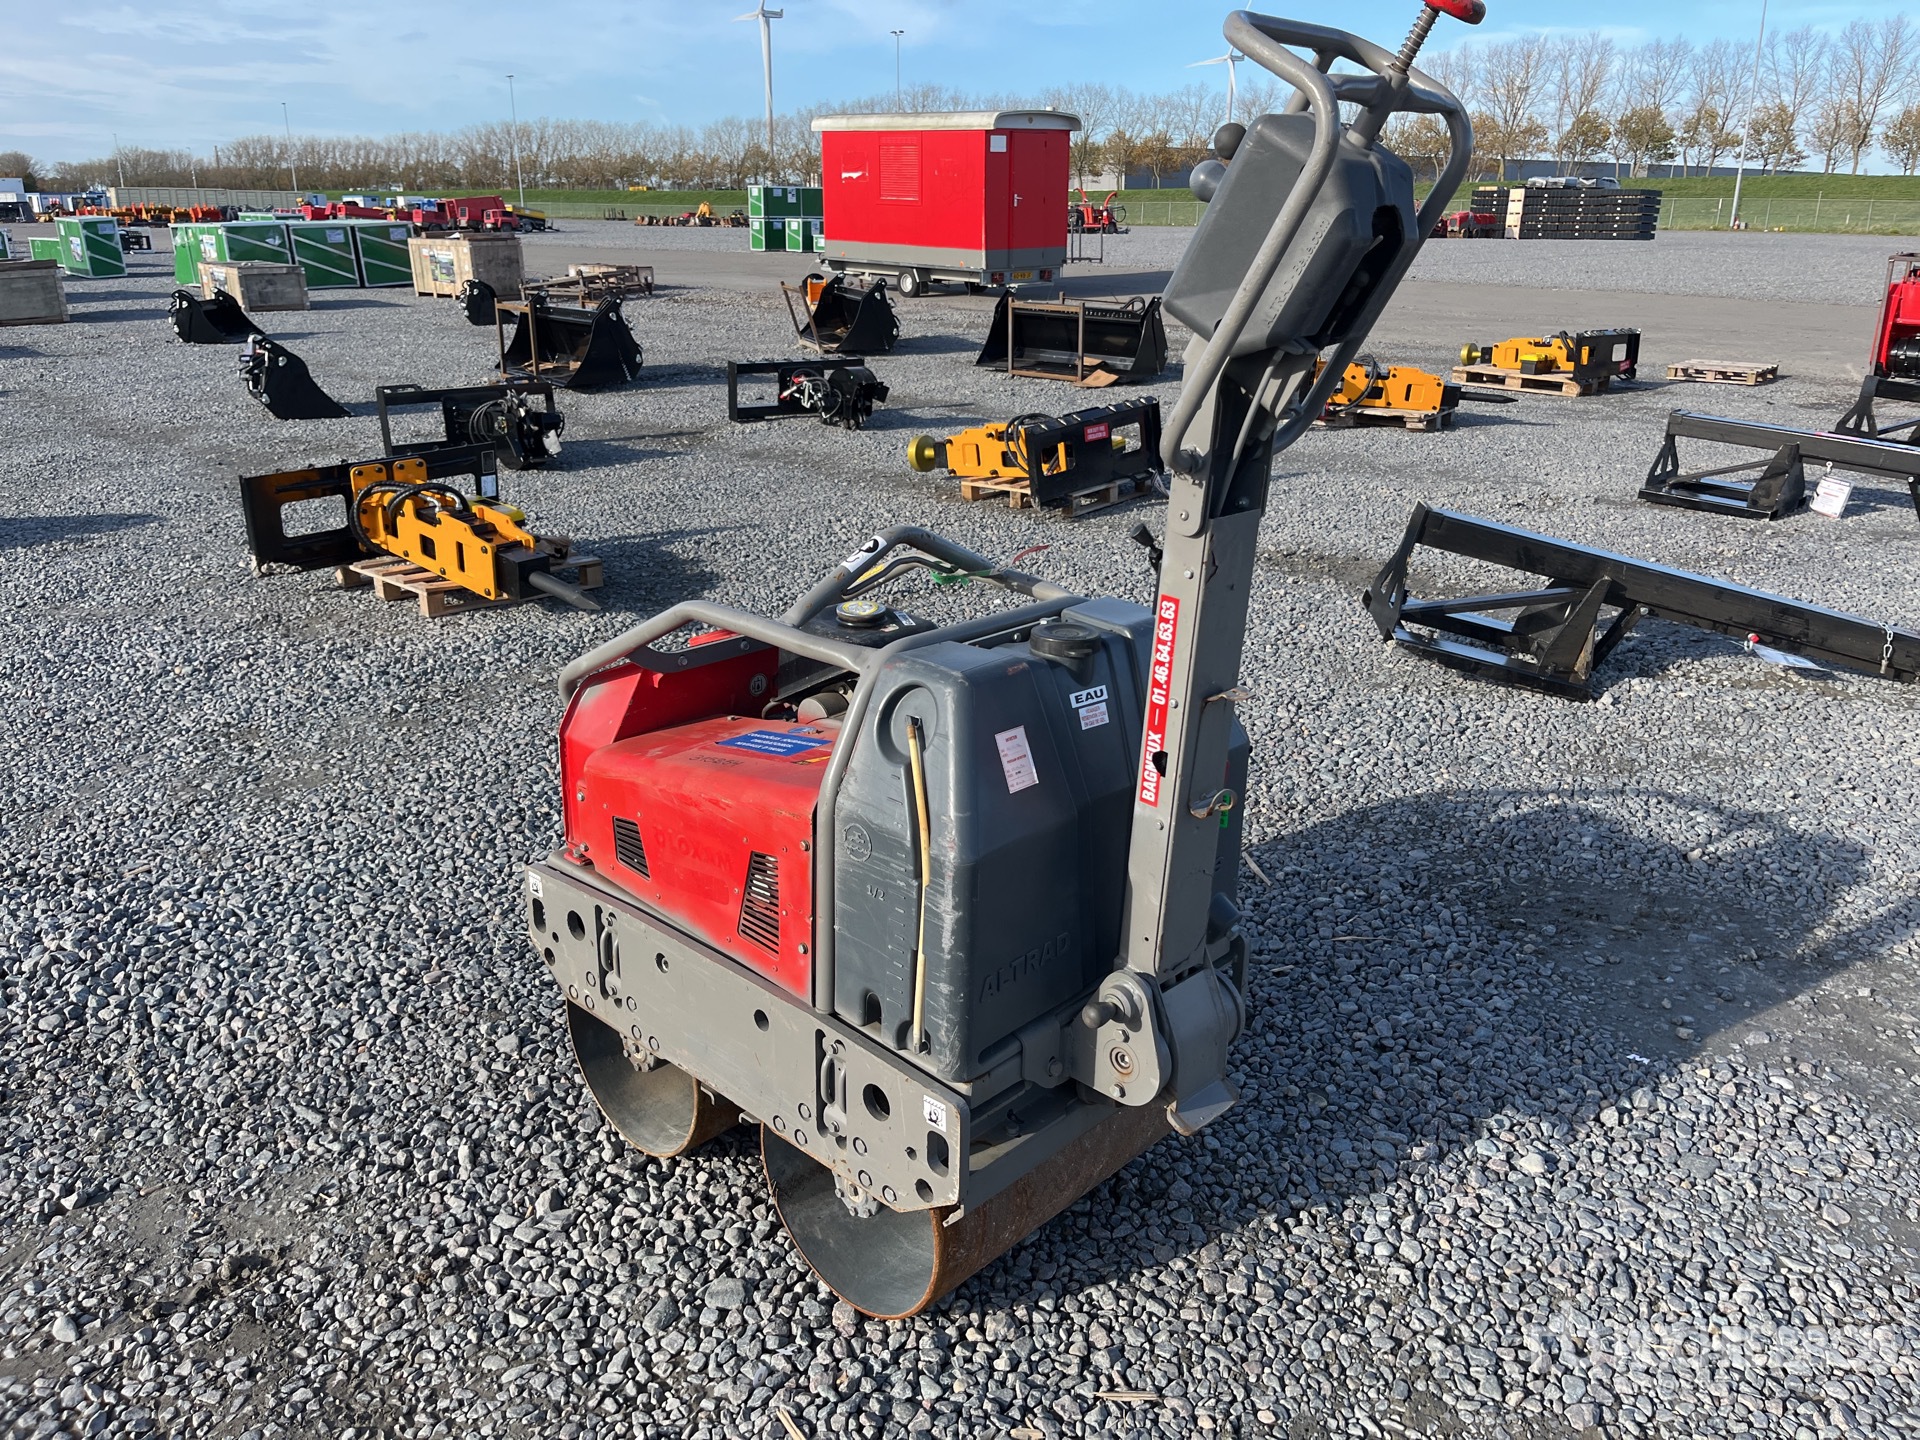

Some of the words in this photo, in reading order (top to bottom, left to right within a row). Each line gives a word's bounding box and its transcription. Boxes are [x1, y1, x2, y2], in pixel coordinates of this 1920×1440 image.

[1153, 601, 1176, 706] 01.46.64.63.63
[1074, 688, 1104, 704] EAU
[866, 884, 886, 902] 1/2
[979, 931, 1072, 1004] ALTRAD
